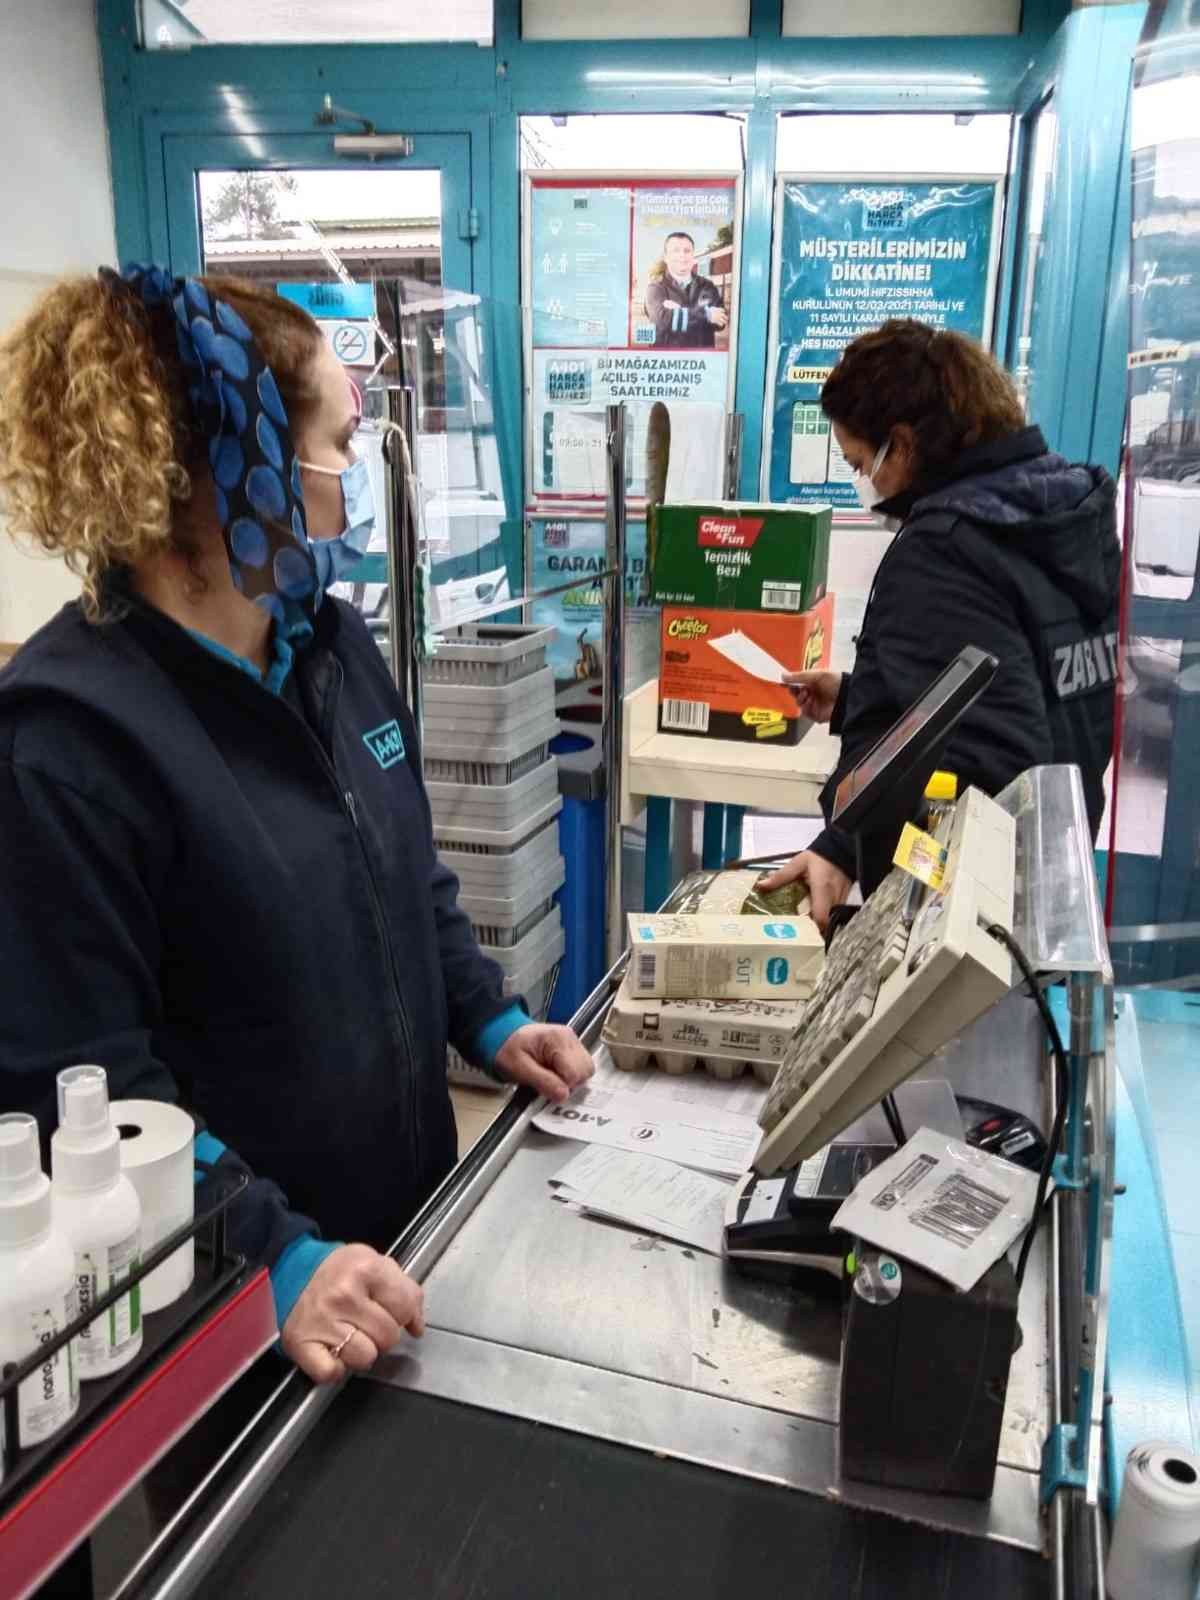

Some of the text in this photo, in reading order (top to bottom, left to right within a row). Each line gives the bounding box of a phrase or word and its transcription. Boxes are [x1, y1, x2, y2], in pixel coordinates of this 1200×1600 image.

[800, 237, 967, 261] MÜŞTERİLERİMİZİN
[831, 262, 932, 281] DİKKATİNE!
[615, 356, 707, 370] MAĞAZAMIZDA
[601, 373, 638, 384] AÇILIŞ
[647, 372, 702, 385] KAPANIŞ
[793, 367, 828, 379] LÜTFEN
[701, 521, 736, 534] Clean
[704, 550, 752, 566] Temizlik
[716, 564, 741, 577] Bezi
